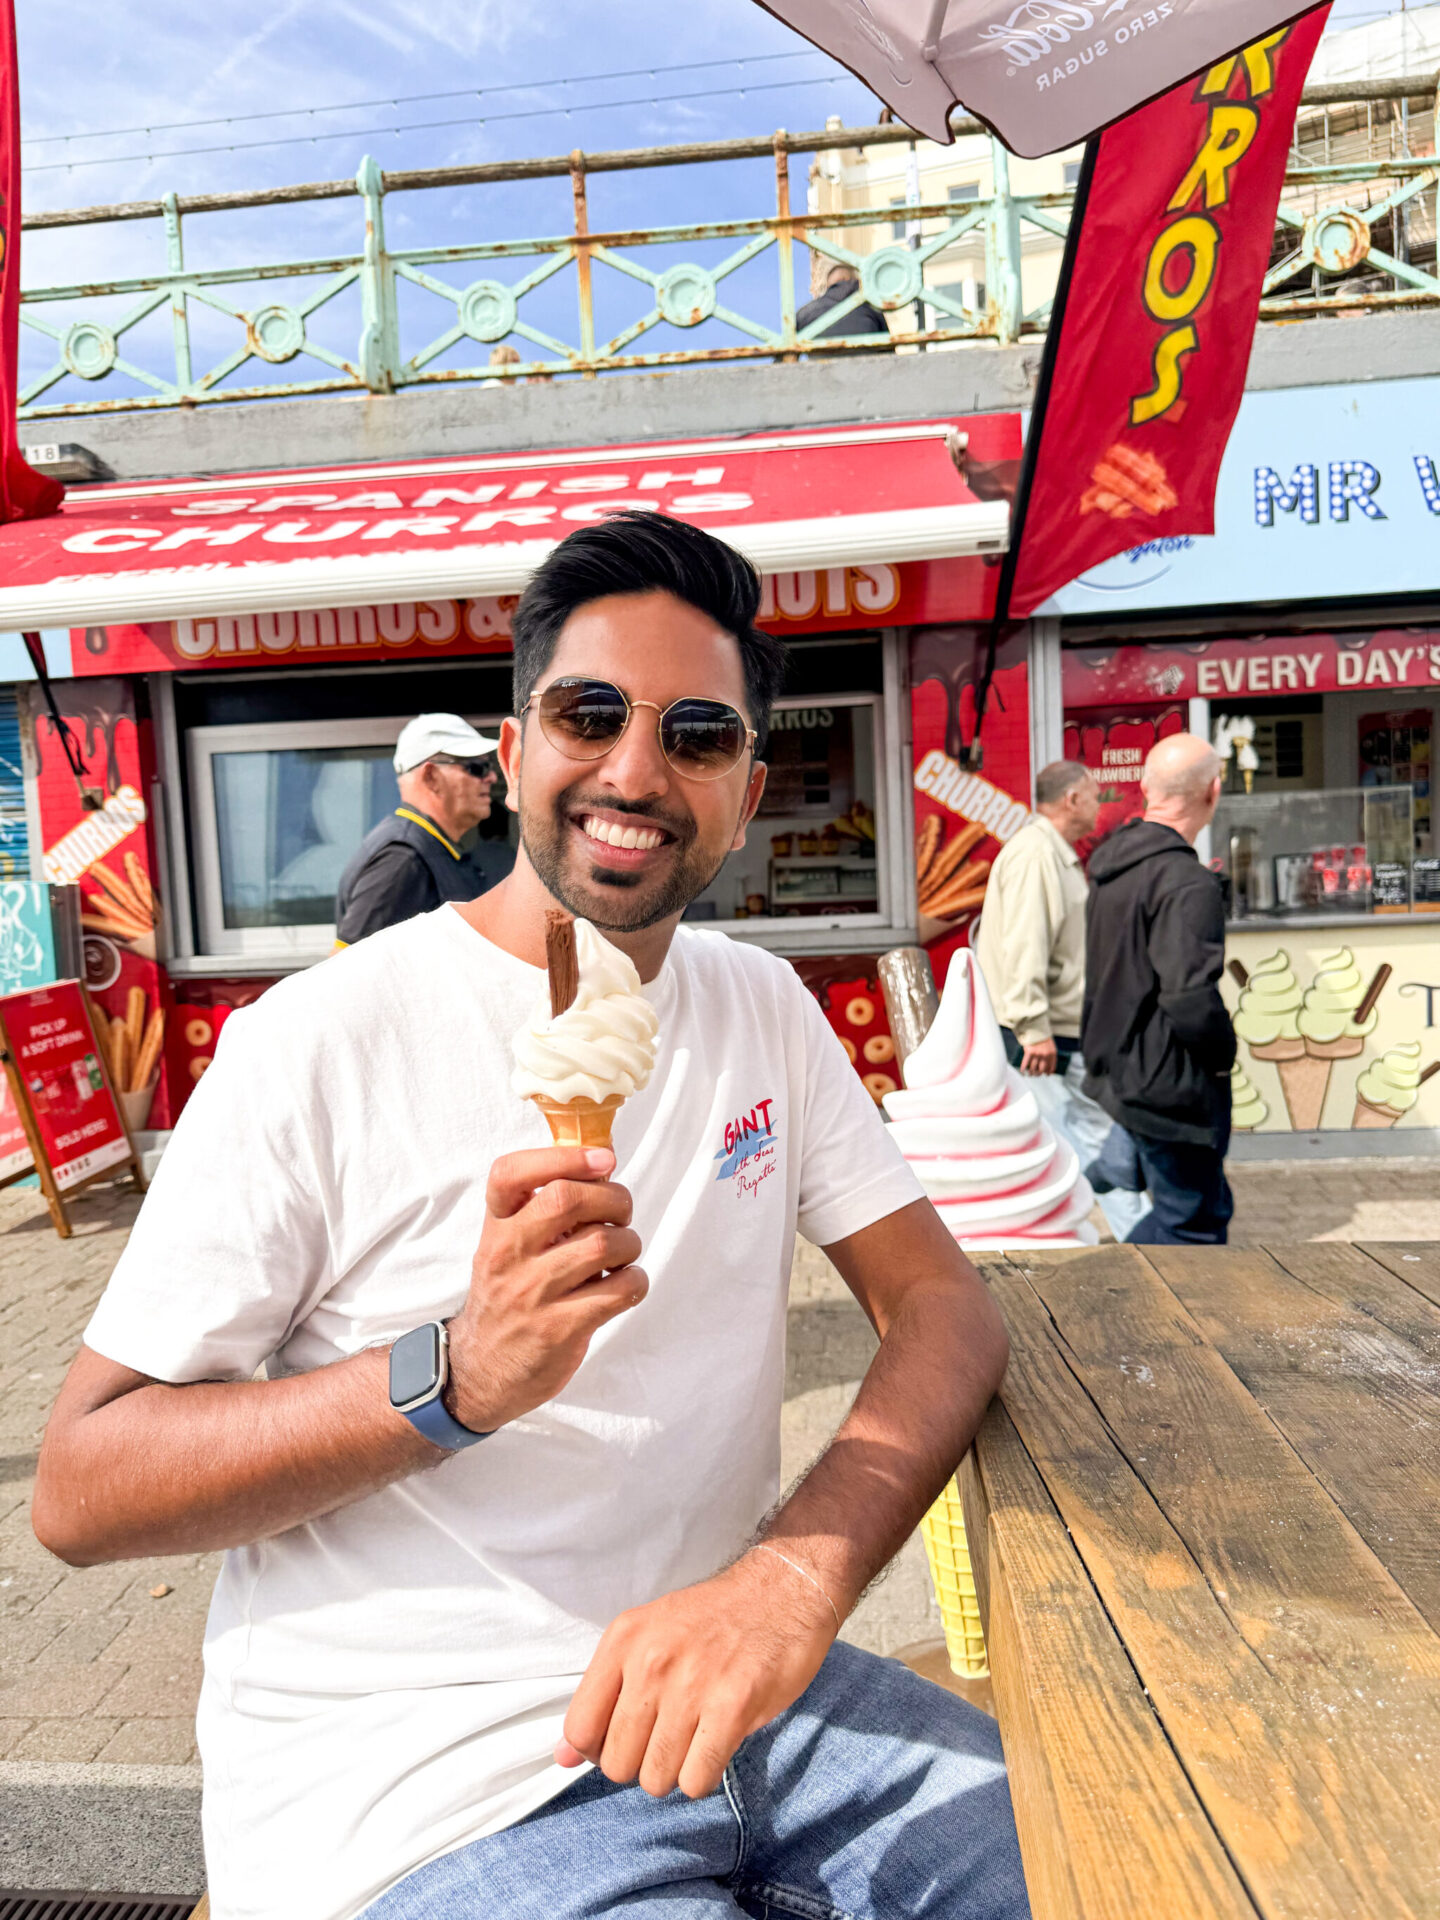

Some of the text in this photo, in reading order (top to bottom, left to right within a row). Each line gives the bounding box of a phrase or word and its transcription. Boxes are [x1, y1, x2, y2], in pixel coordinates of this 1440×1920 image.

[171, 467, 726, 516] SPANISH
[1254, 461, 1389, 528] MR
[60, 492, 754, 554] CHURROS
[1197, 653, 1323, 694] EVERY
[1102, 747, 1142, 766] FRESH
[914, 749, 1033, 844] CHURRO
[42, 785, 146, 886] CHURROS
[29, 1022, 51, 1038] PICK
[31, 1038, 55, 1056] SOFT
[56, 1030, 85, 1048] DRINK
[55, 1129, 82, 1150] SOLD
[724, 1098, 773, 1155] GANT
